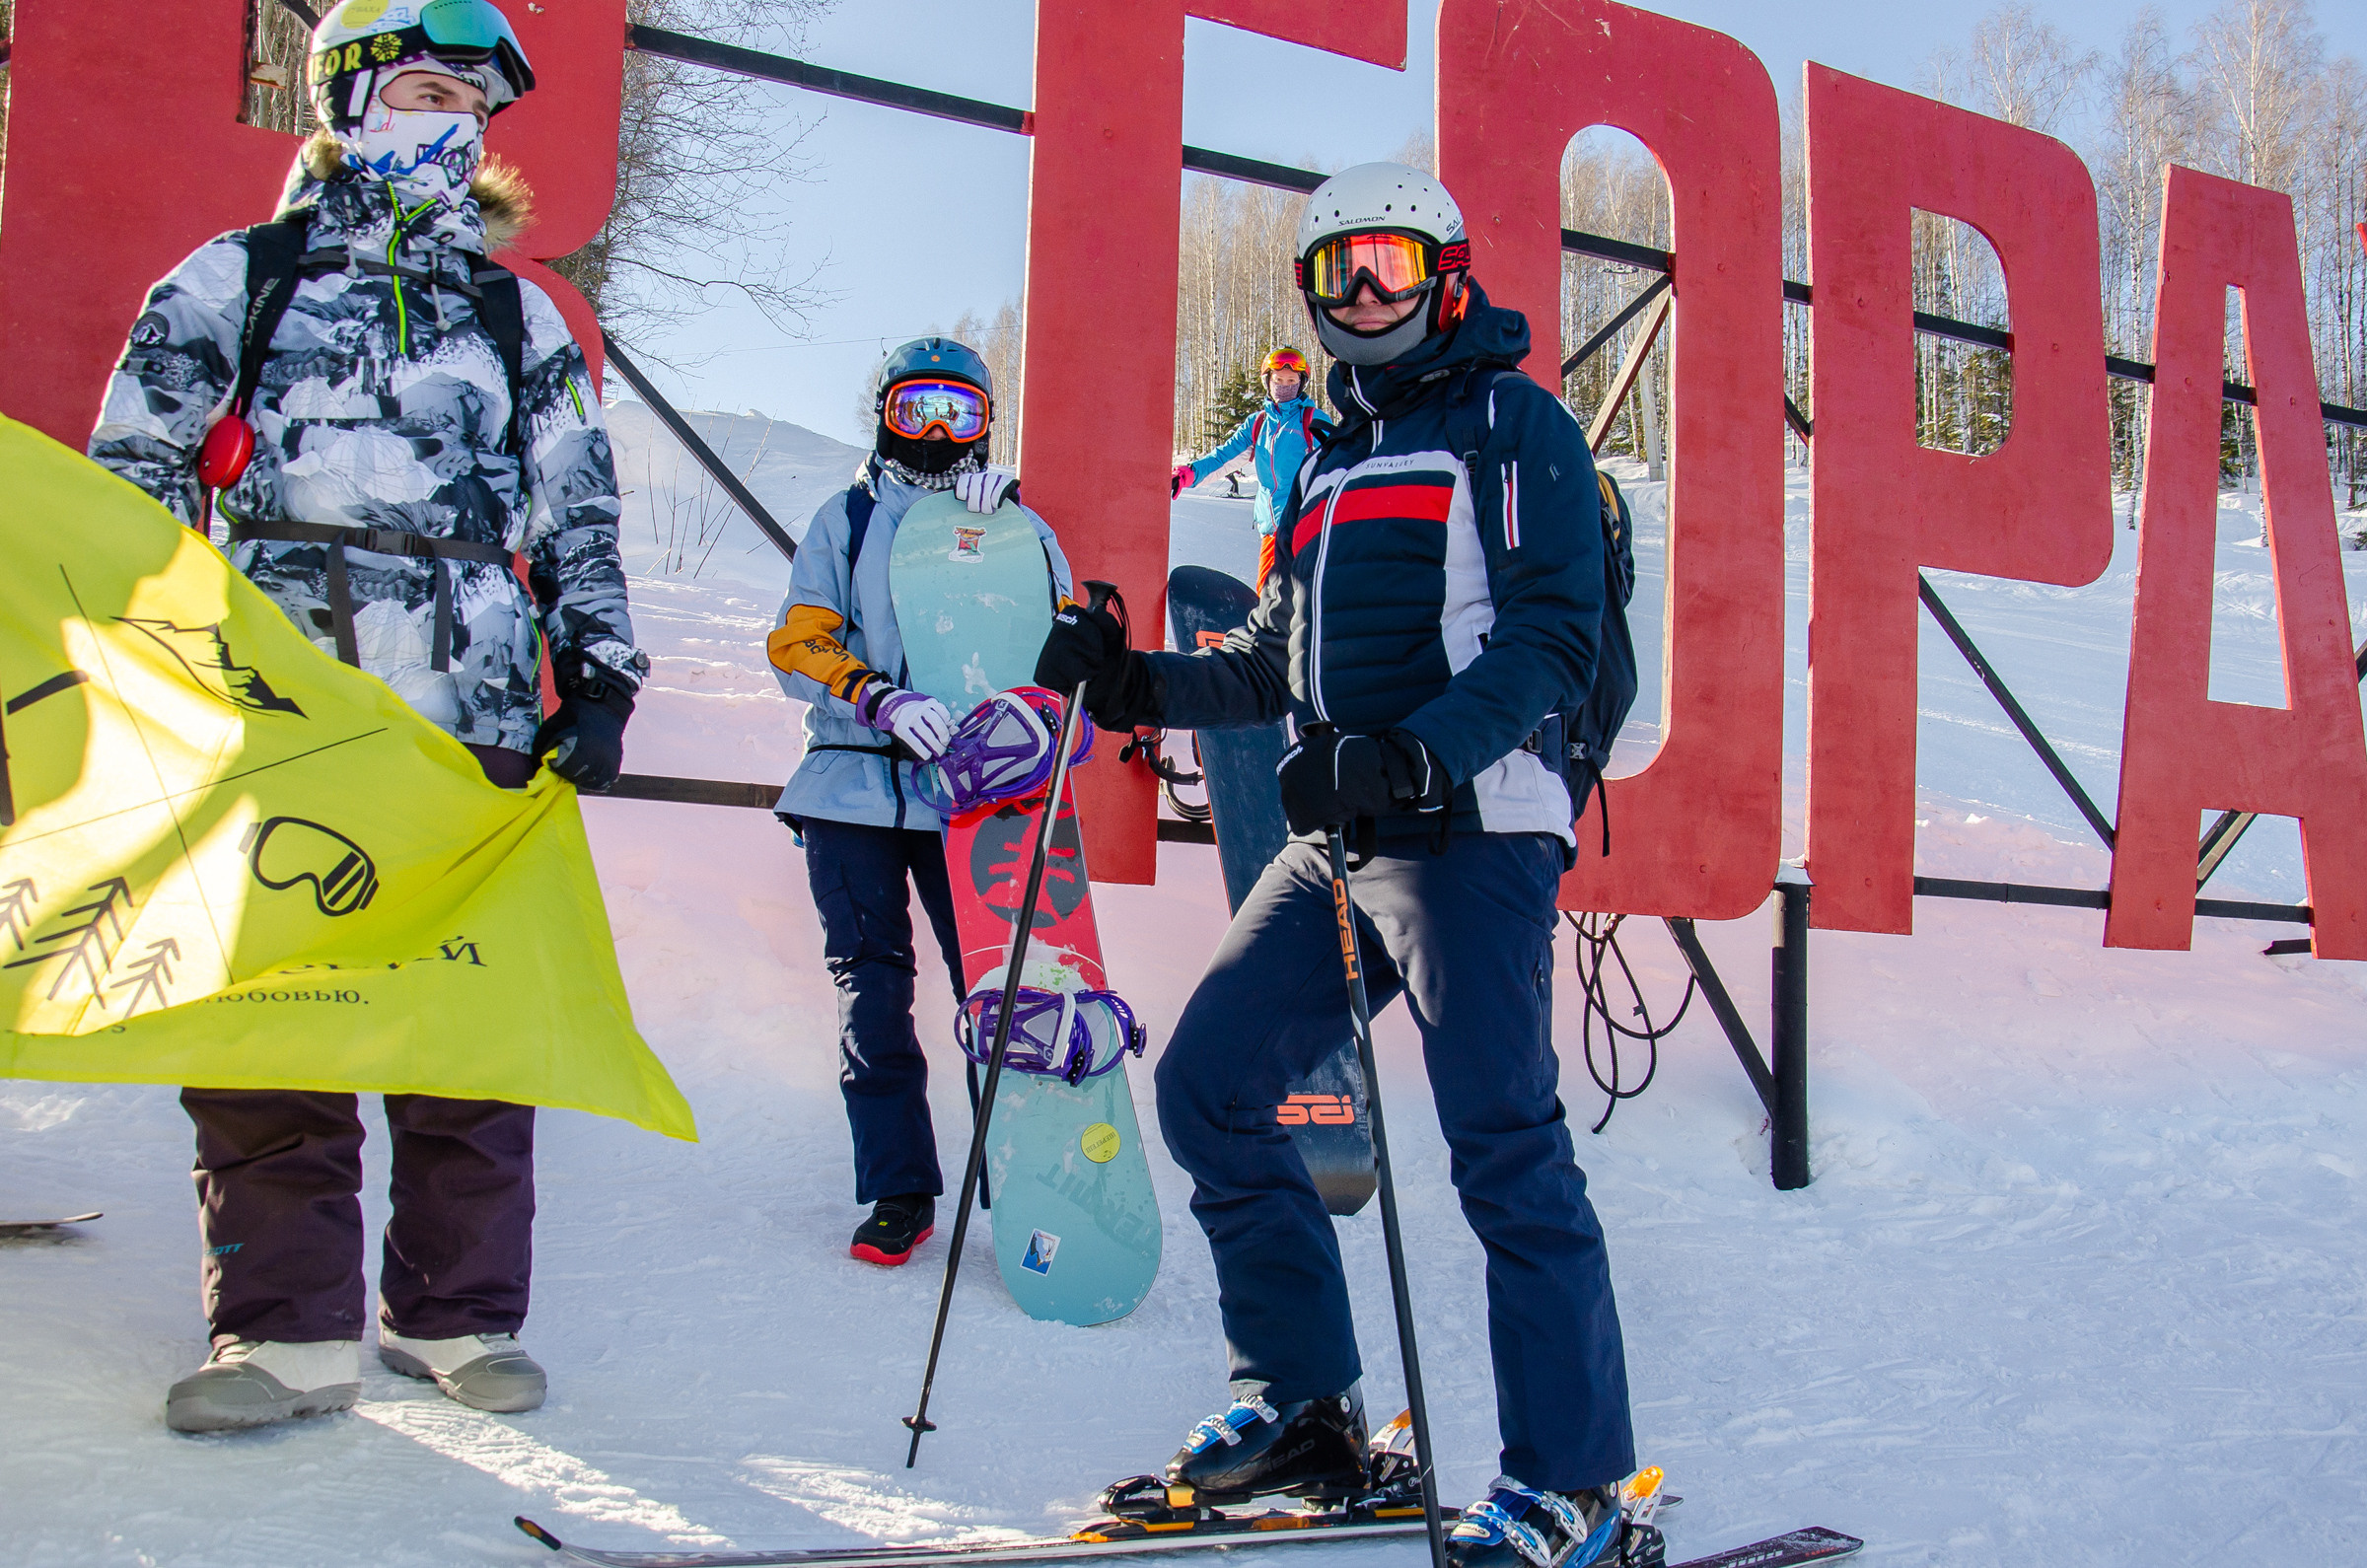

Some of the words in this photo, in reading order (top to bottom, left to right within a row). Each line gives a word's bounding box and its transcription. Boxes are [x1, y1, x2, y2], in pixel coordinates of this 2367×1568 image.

[1338, 216, 1385, 226] SALOMON
[1024, 0, 2367, 961] ГОРА
[1332, 877, 1360, 980] HEAD
[194, 986, 370, 1006] юбовью.
